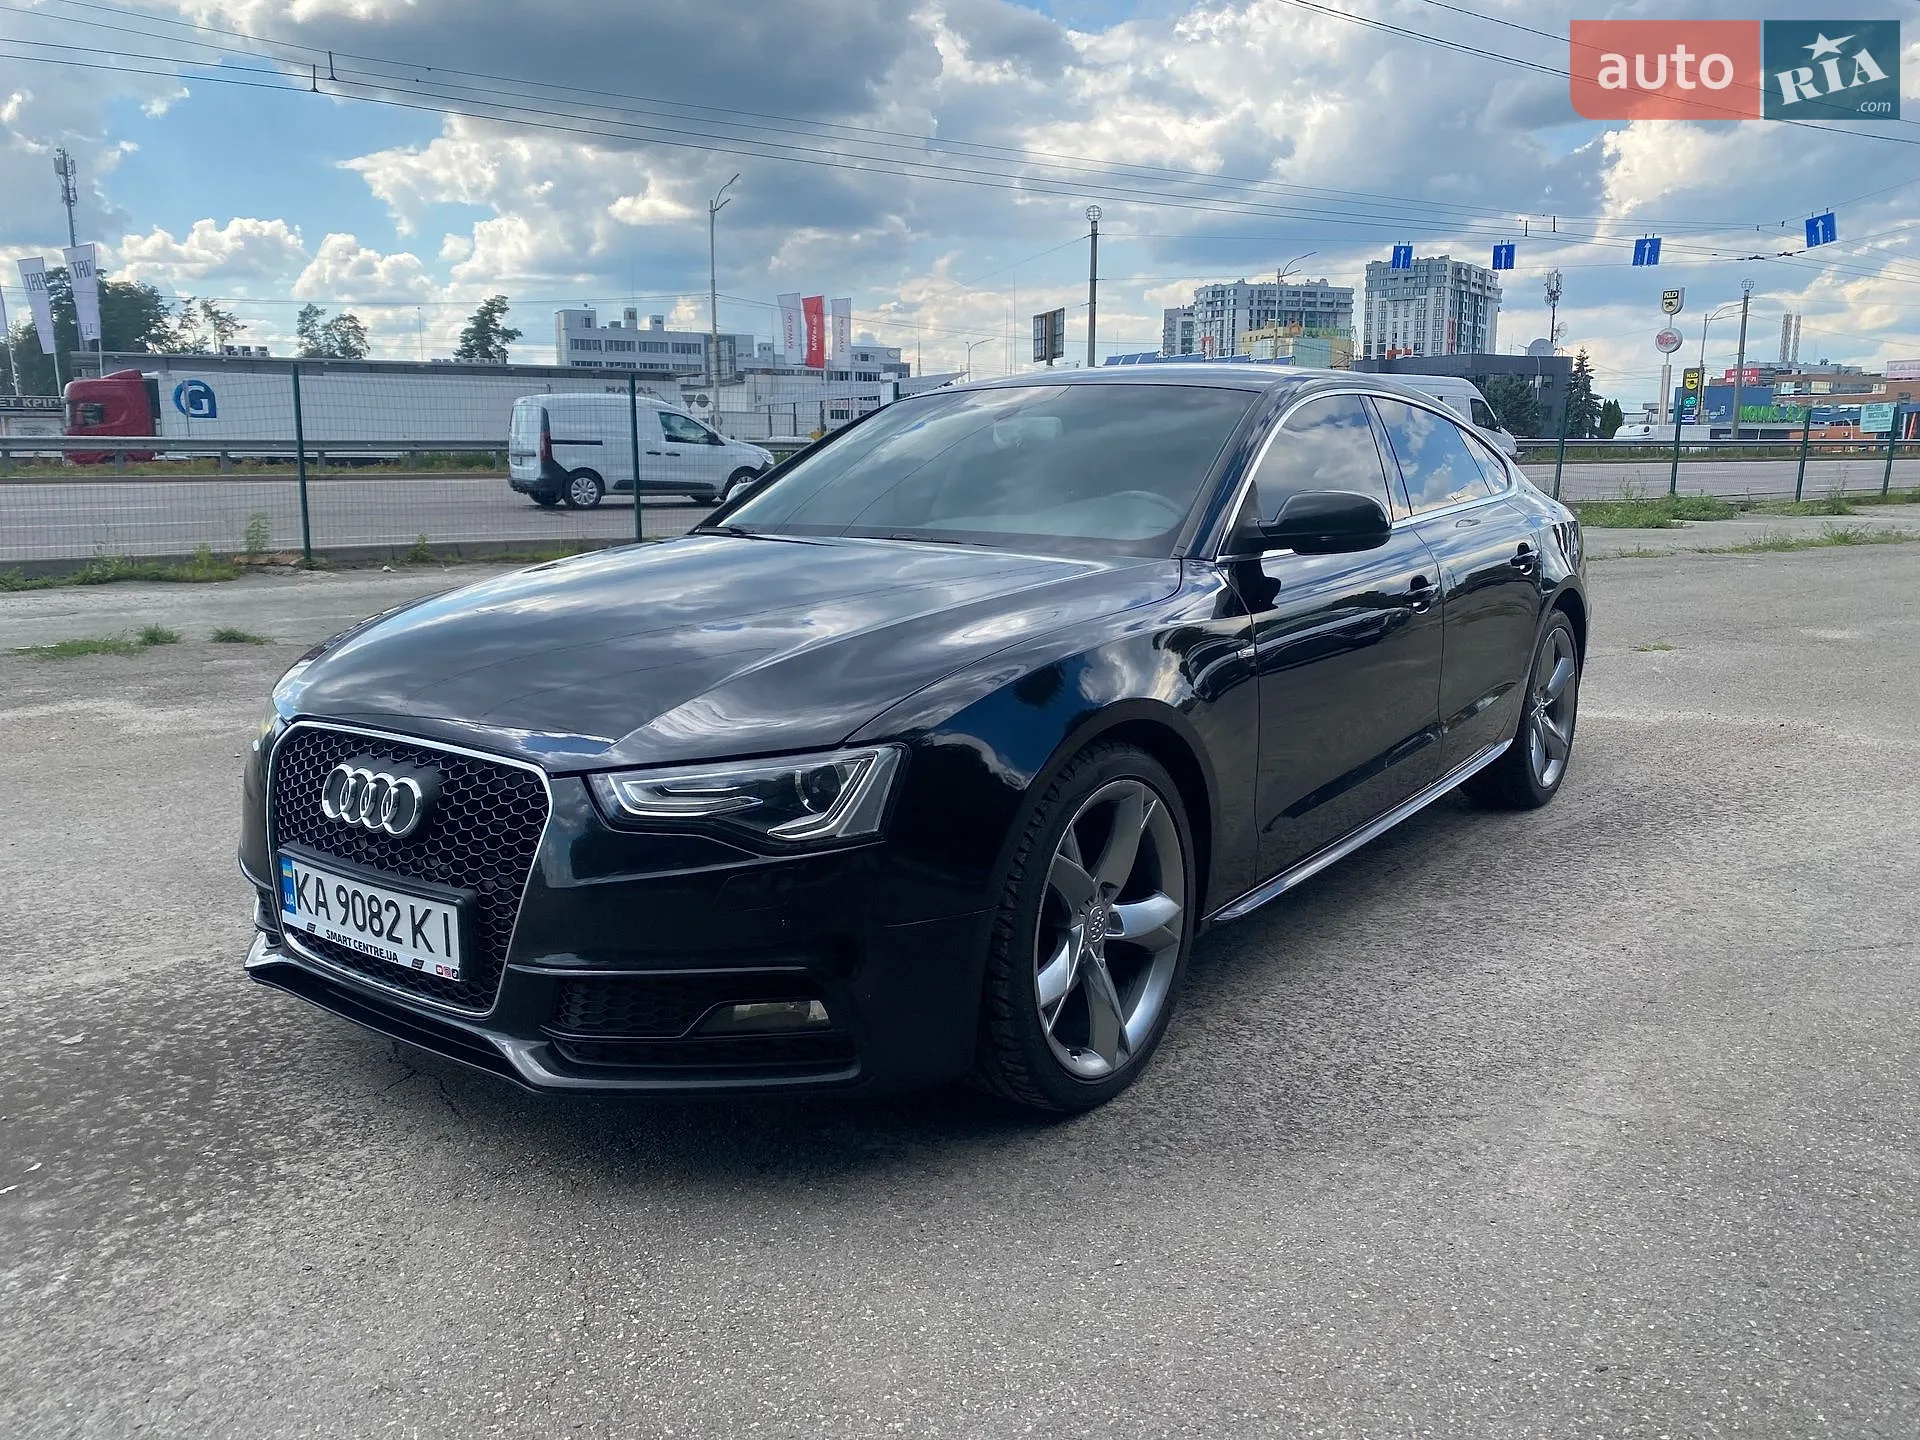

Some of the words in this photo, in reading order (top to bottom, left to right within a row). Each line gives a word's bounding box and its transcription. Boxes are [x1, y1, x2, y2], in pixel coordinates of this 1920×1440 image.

[1664, 291, 1677, 299] KLO
[285, 891, 295, 907] UA
[295, 869, 331, 921] KA
[336, 884, 402, 945] 9082
[410, 904, 451, 957] KI
[325, 929, 352, 947] SMART
[353, 939, 398, 963] CENTRE.UA
